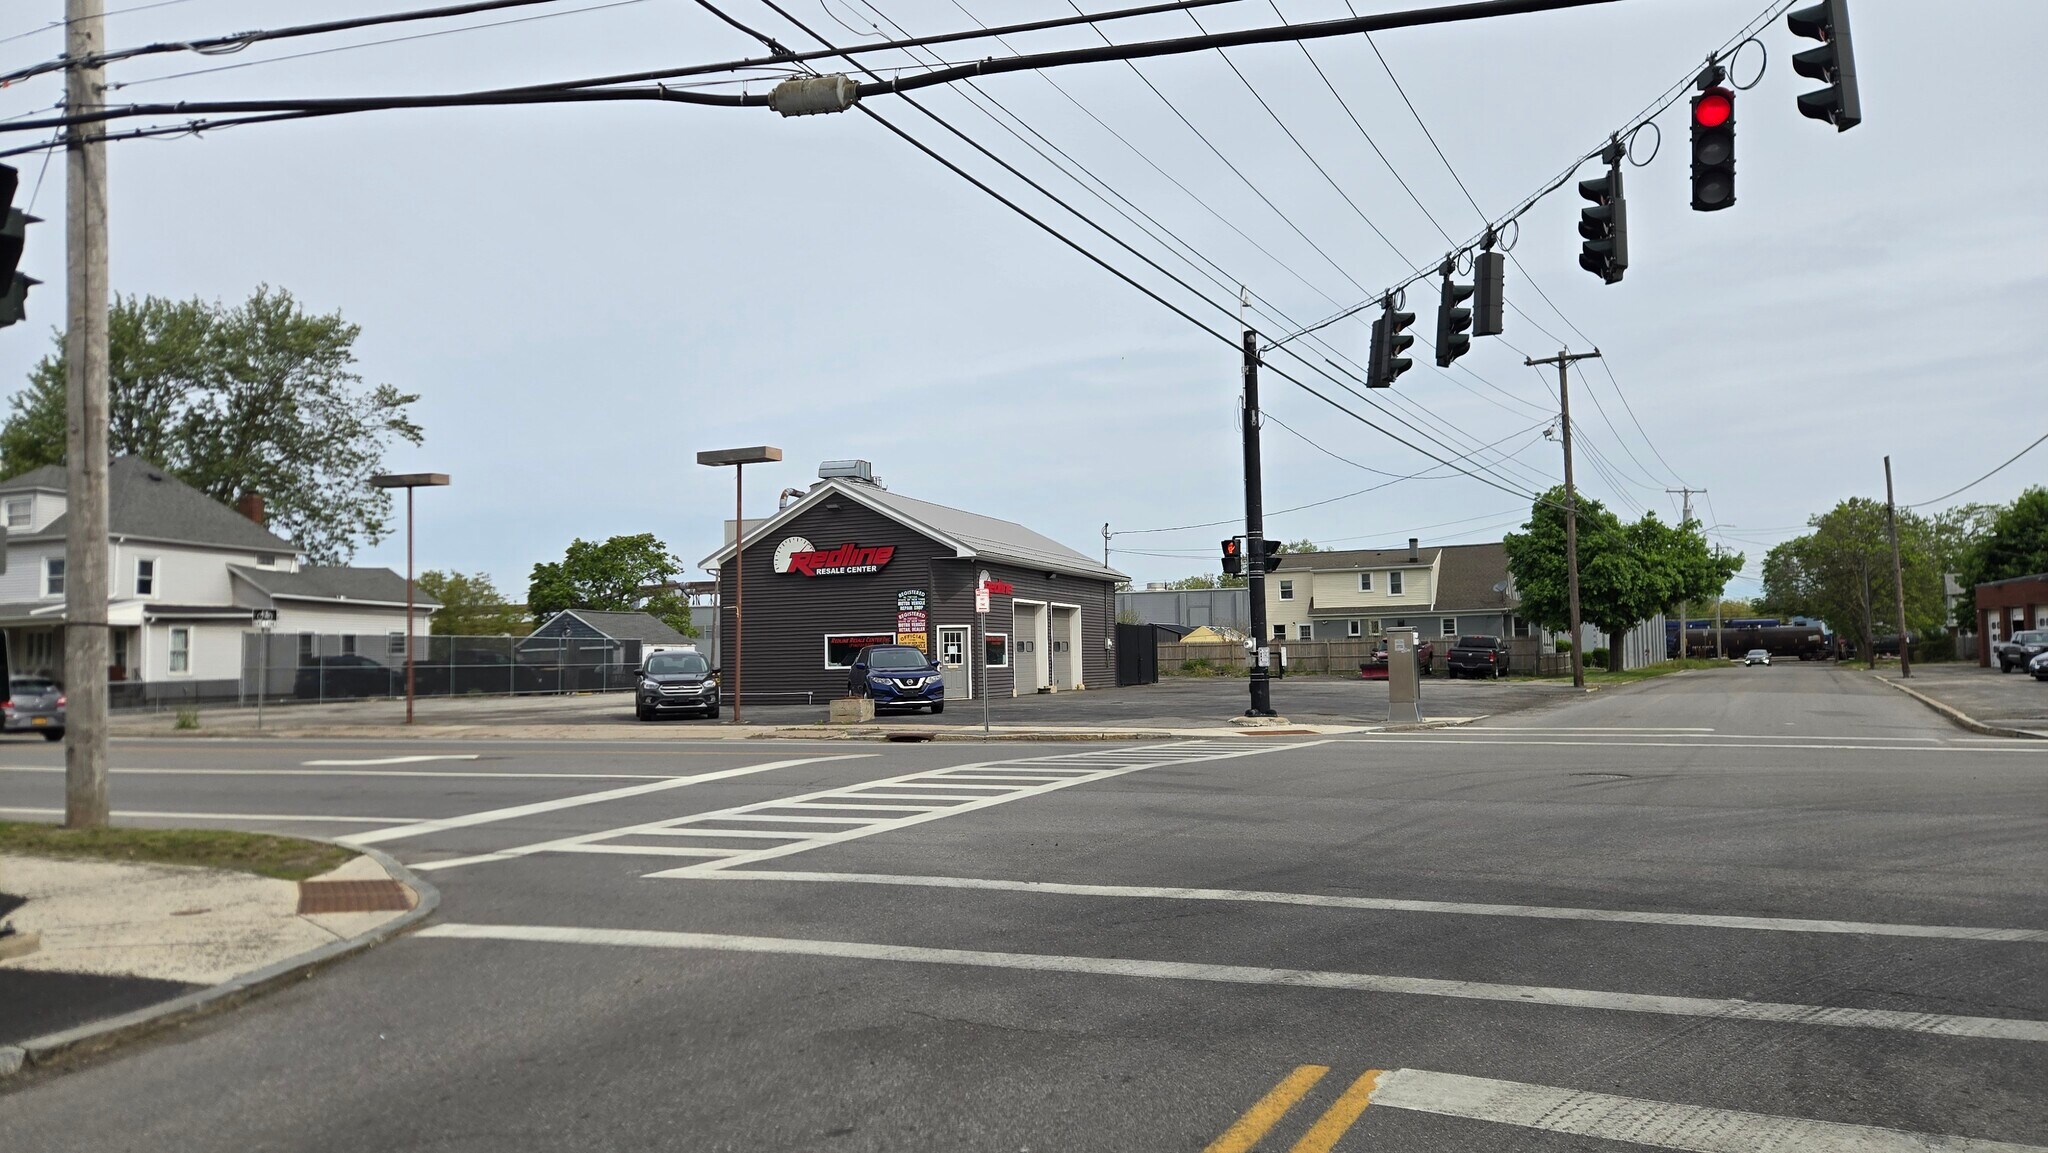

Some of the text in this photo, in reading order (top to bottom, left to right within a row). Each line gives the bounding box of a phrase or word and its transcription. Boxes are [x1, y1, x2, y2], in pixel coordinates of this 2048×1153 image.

[788, 543, 896, 576] Redline
[816, 565, 877, 575] RESALE CENTER
[898, 590, 926, 598] REGISTERED
[898, 611, 926, 619] REGISTERED
